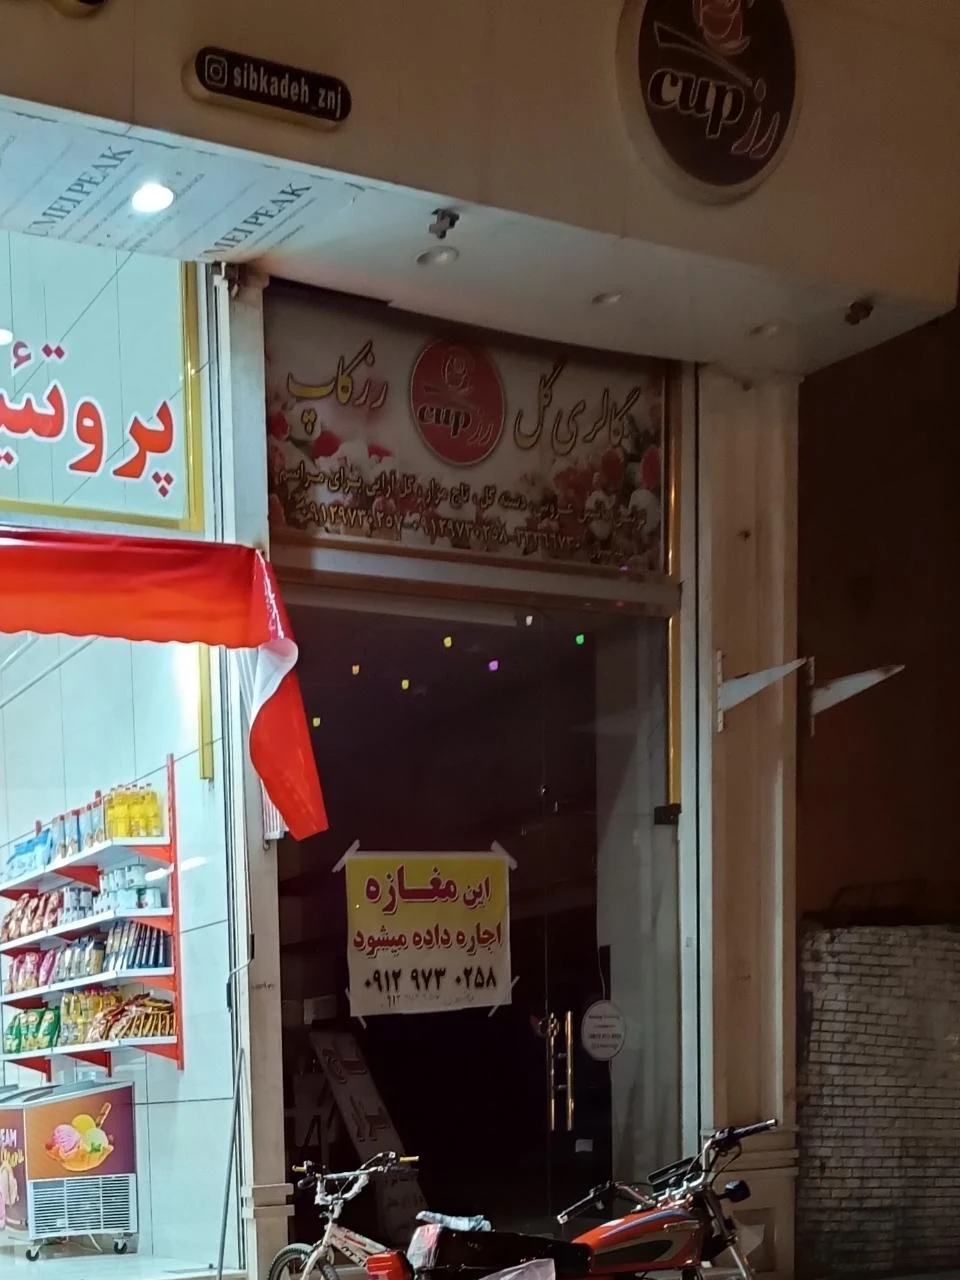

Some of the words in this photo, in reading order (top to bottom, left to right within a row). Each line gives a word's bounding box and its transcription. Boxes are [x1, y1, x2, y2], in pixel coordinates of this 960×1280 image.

[648, 67, 746, 140] cup
[417, 403, 472, 438] cup
[365, 864, 459, 914] مغازه
[463, 875, 492, 909] این
[353, 925, 410, 958] میشود
[412, 923, 453, 949] داده
[456, 922, 503, 956] اجاره
[410, 967, 447, 992] ۹۷۳
